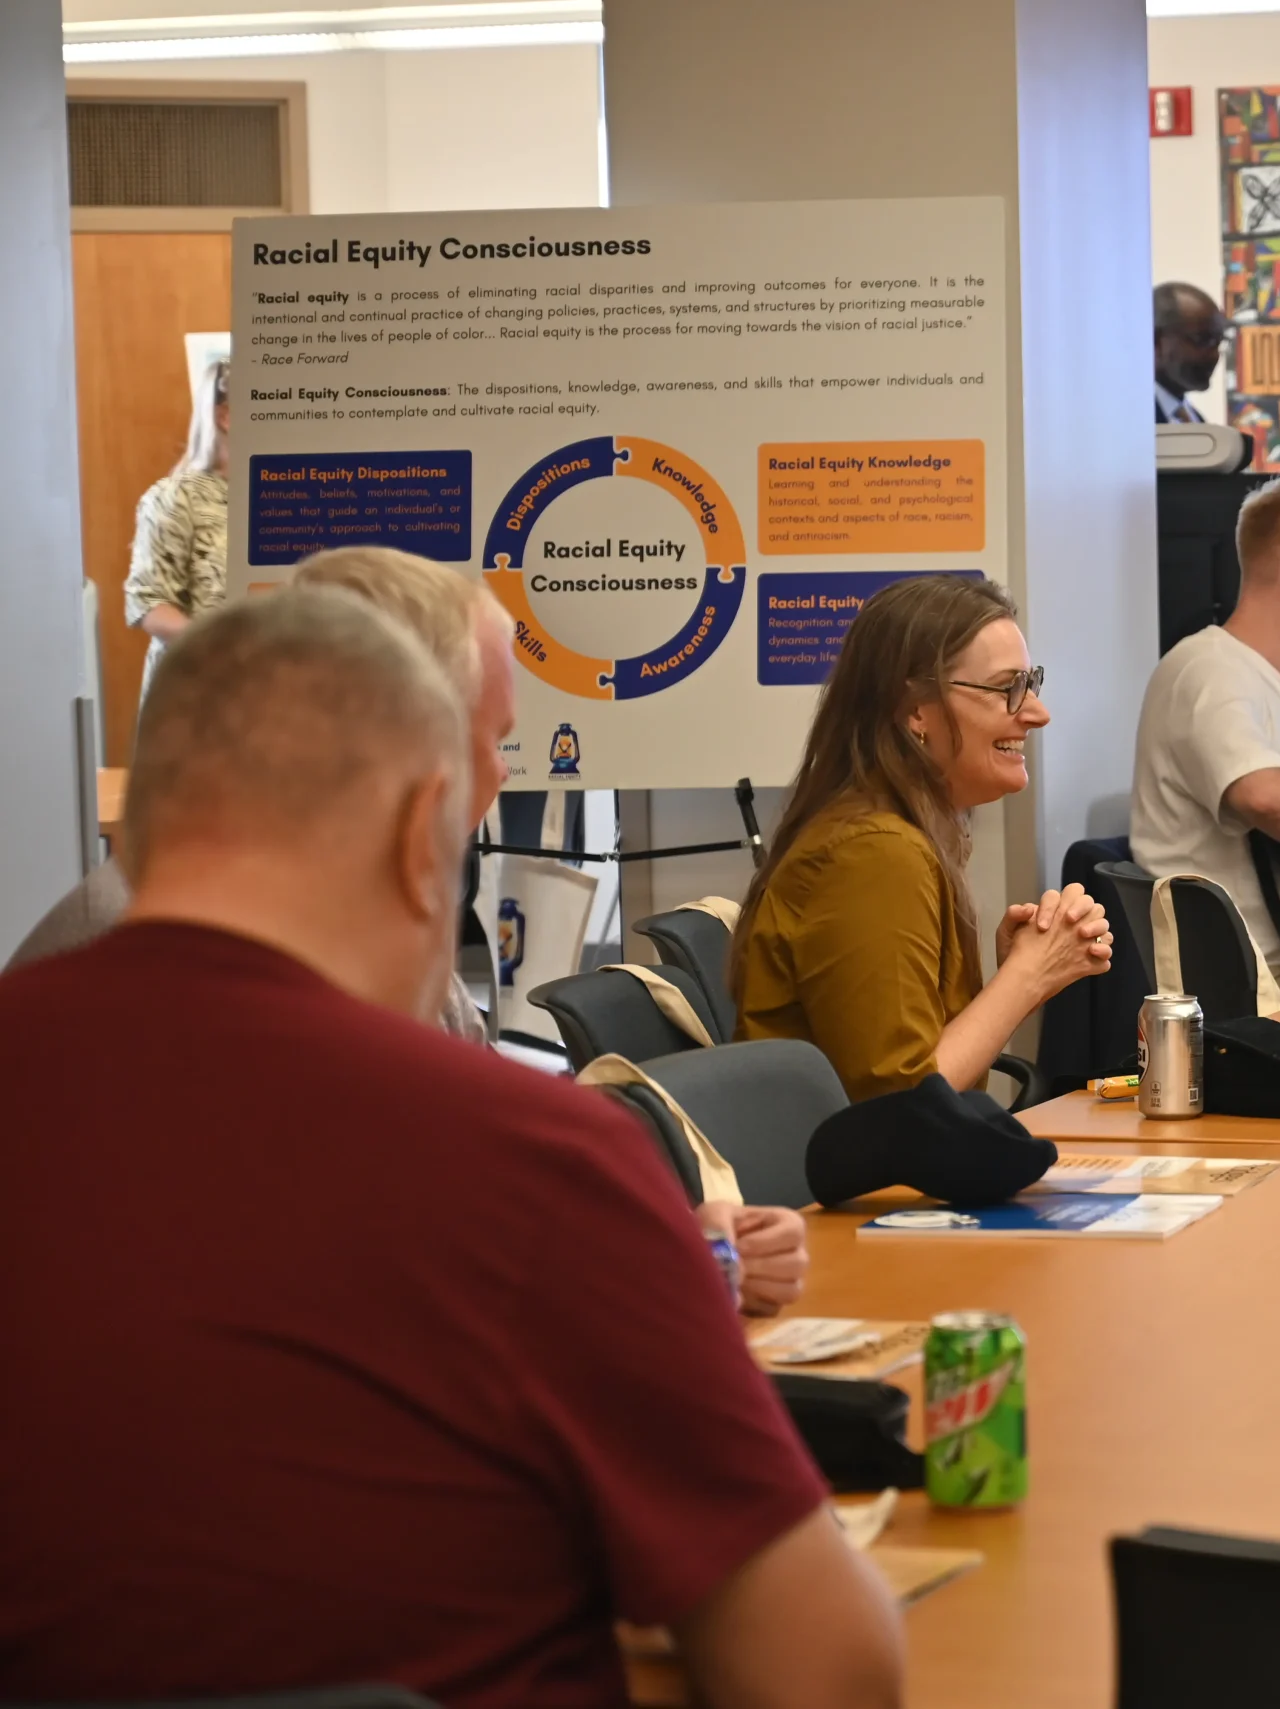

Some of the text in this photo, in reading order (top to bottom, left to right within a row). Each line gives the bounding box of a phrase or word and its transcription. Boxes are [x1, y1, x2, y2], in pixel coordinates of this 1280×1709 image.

[254, 236, 651, 269] Racial Equity Consciousness
[308, 291, 349, 305] equity
[358, 292, 366, 301] is
[391, 291, 439, 303] process
[447, 286, 460, 298] of
[468, 286, 536, 300] eliminating
[546, 284, 580, 296] racial
[589, 283, 653, 298] disparities
[662, 281, 685, 293] and
[695, 282, 755, 295] improving
[764, 281, 826, 290] outcomes
[835, 277, 852, 289] for
[860, 279, 920, 291] everyone.
[930, 276, 938, 287] It
[947, 277, 956, 287] is
[964, 274, 984, 286] the
[252, 295, 984, 324] intentional and continual practice of changing policies, practices, systems, and structures by prioritizing measurable
[252, 333, 298, 347] change
[303, 333, 312, 343] in
[317, 331, 336, 343] the
[341, 330, 367, 342] lives
[371, 329, 384, 341] of
[388, 329, 431, 344] people
[436, 328, 448, 340] of
[453, 327, 495, 340] color...
[500, 326, 538, 338] Racial
[543, 327, 581, 340] equity
[586, 326, 594, 336] is
[599, 324, 618, 335] the
[623, 323, 671, 338] process
[676, 322, 693, 334] for
[697, 323, 741, 336] moving
[746, 320, 797, 332] towards
[801, 319, 821, 331] the
[826, 320, 860, 330] vision
[865, 318, 877, 330] of
[882, 317, 917, 329] racial
[262, 354, 293, 365] Race
[297, 351, 349, 364] Forward
[251, 372, 984, 402] Racial Equity Consciousness: The dispositions, knowledge, awareness, and skills that empower individuals and
[251, 402, 599, 421] communities to contemplate and cultivate racial equity.
[769, 454, 951, 472] Racial Equity Knowledge
[261, 466, 447, 483] Racial Equity Dispositions
[769, 475, 973, 491] Learning and understanding the
[260, 486, 462, 499] Attitudes, beliefs, motivations, and
[507, 456, 591, 531] Dispositions
[651, 457, 718, 534] Knowledge
[769, 493, 973, 507] historical, social, and psychological
[260, 507, 293, 517] values
[300, 507, 320, 516] that
[328, 505, 358, 518] guide
[385, 503, 443, 514] individual's
[769, 511, 973, 524] contexts and aspects of race, racism,
[259, 522, 461, 536] community's approach to cultivating
[769, 531, 849, 542] and antiracism.
[259, 541, 288, 551] racial
[544, 539, 685, 562] Racial Equity
[531, 574, 697, 592] Consciousness
[769, 595, 864, 611] Racial Equity
[769, 617, 833, 630] Recognition
[516, 620, 546, 662] Skills
[639, 605, 716, 679] Awareness
[769, 636, 820, 647] dynamics
[769, 652, 818, 665] everyday
[503, 742, 520, 751] and
